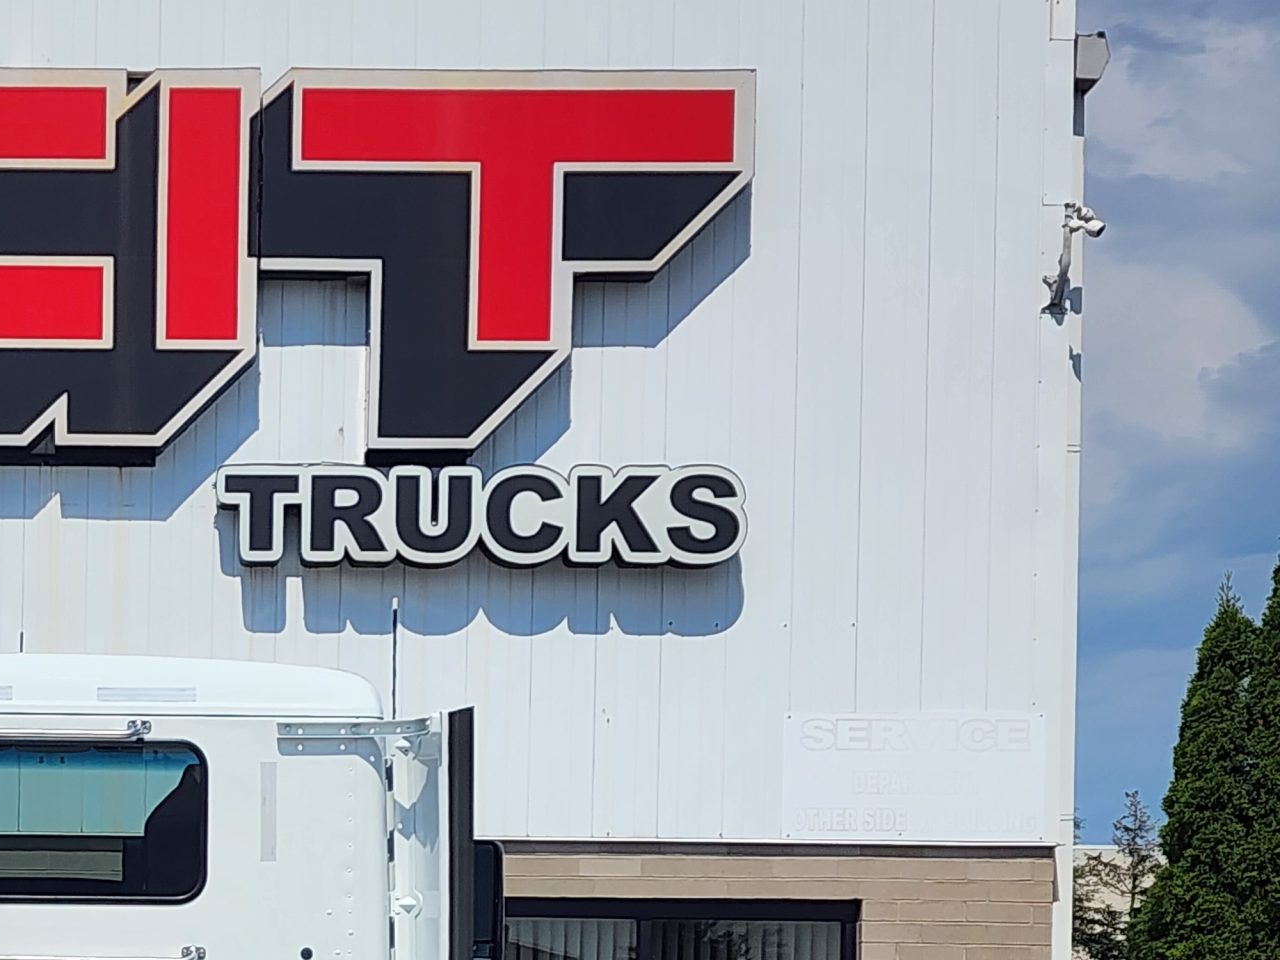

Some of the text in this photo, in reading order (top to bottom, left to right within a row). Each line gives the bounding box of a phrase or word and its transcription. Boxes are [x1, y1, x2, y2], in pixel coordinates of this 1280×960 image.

[219, 467, 746, 566] TRUCKS
[795, 807, 858, 832] OTHER
[862, 807, 908, 832] SIDE
